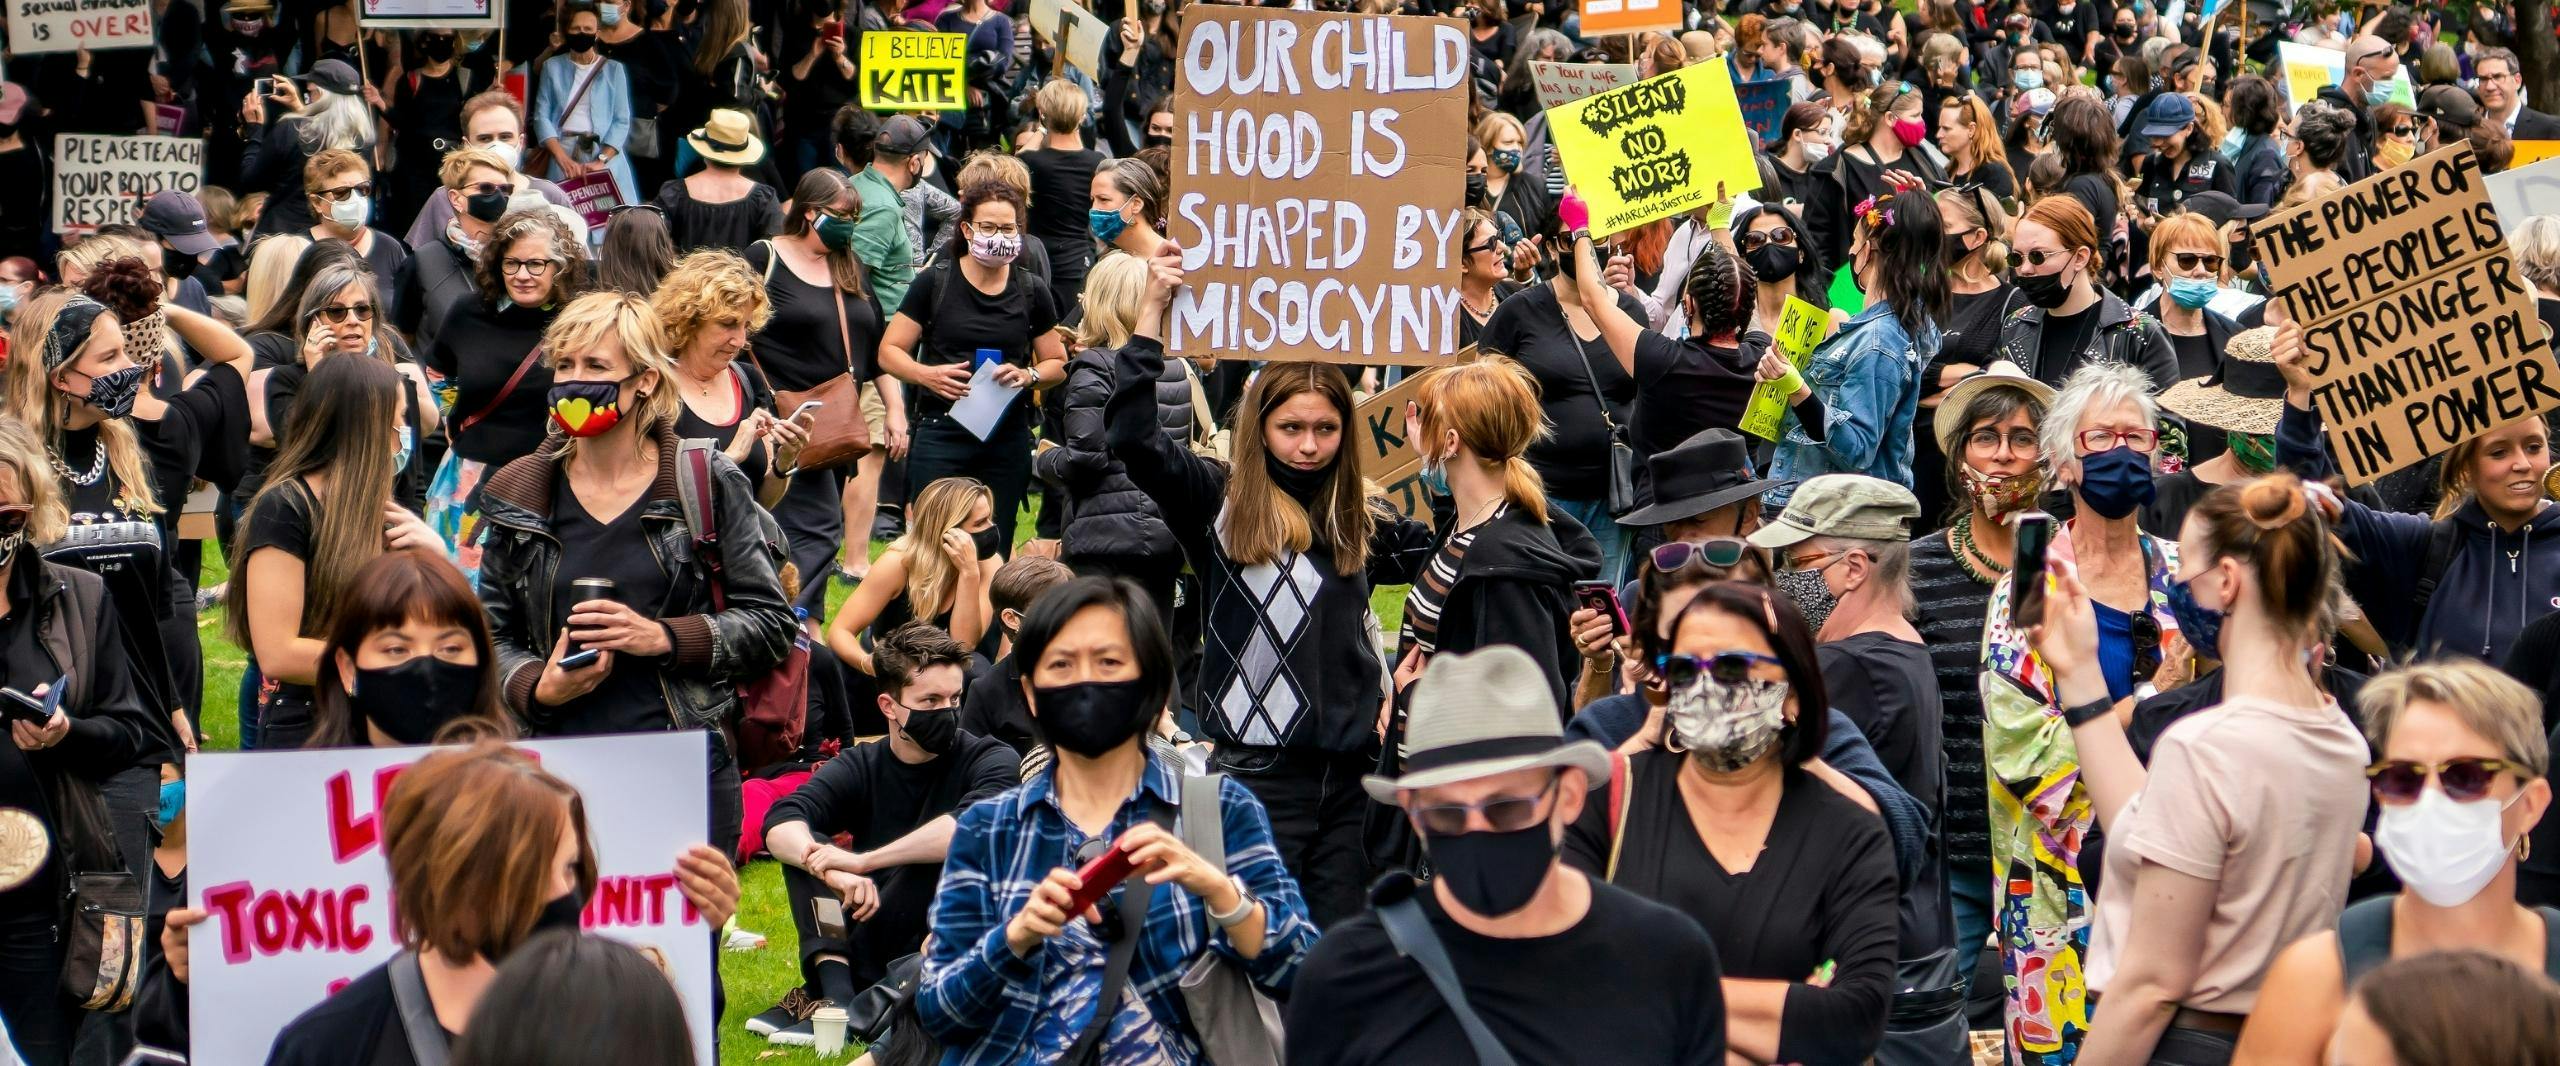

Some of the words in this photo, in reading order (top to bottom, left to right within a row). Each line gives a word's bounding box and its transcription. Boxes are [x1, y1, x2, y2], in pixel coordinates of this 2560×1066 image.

[70, 10, 149, 37] OVER!
[868, 36, 875, 60] I
[890, 36, 964, 60] BELIEVE
[1183, 18, 1301, 95] OUR
[1311, 17, 1468, 95] CHILD
[869, 67, 956, 104] KATE
[1584, 78, 1680, 123] #SILENT
[1186, 107, 1323, 179] HOOD
[1350, 107, 1406, 178] IS
[1627, 130, 1662, 157] NO
[58, 170, 113, 198] YOUR
[118, 170, 162, 195] BOYS
[168, 170, 198, 193] TO
[1618, 157, 1687, 195] MORE
[62, 197, 149, 225] RESPE
[1604, 190, 1703, 229] #MARCH4JUSTICE
[2256, 210, 2325, 267] THE
[2321, 170, 2430, 243] POWER
[2431, 150, 2478, 195] OF
[1172, 192, 1366, 271] SHAPED
[1393, 204, 1461, 269] BY
[2277, 267, 2350, 330] THE
[2343, 214, 2465, 302] PEOPLE
[2462, 201, 2504, 251] IS
[1170, 276, 1461, 355] MISOGYNY
[2470, 309, 2548, 366] PPL
[2342, 420, 2395, 477] IN
[2404, 358, 2560, 458] POWER
